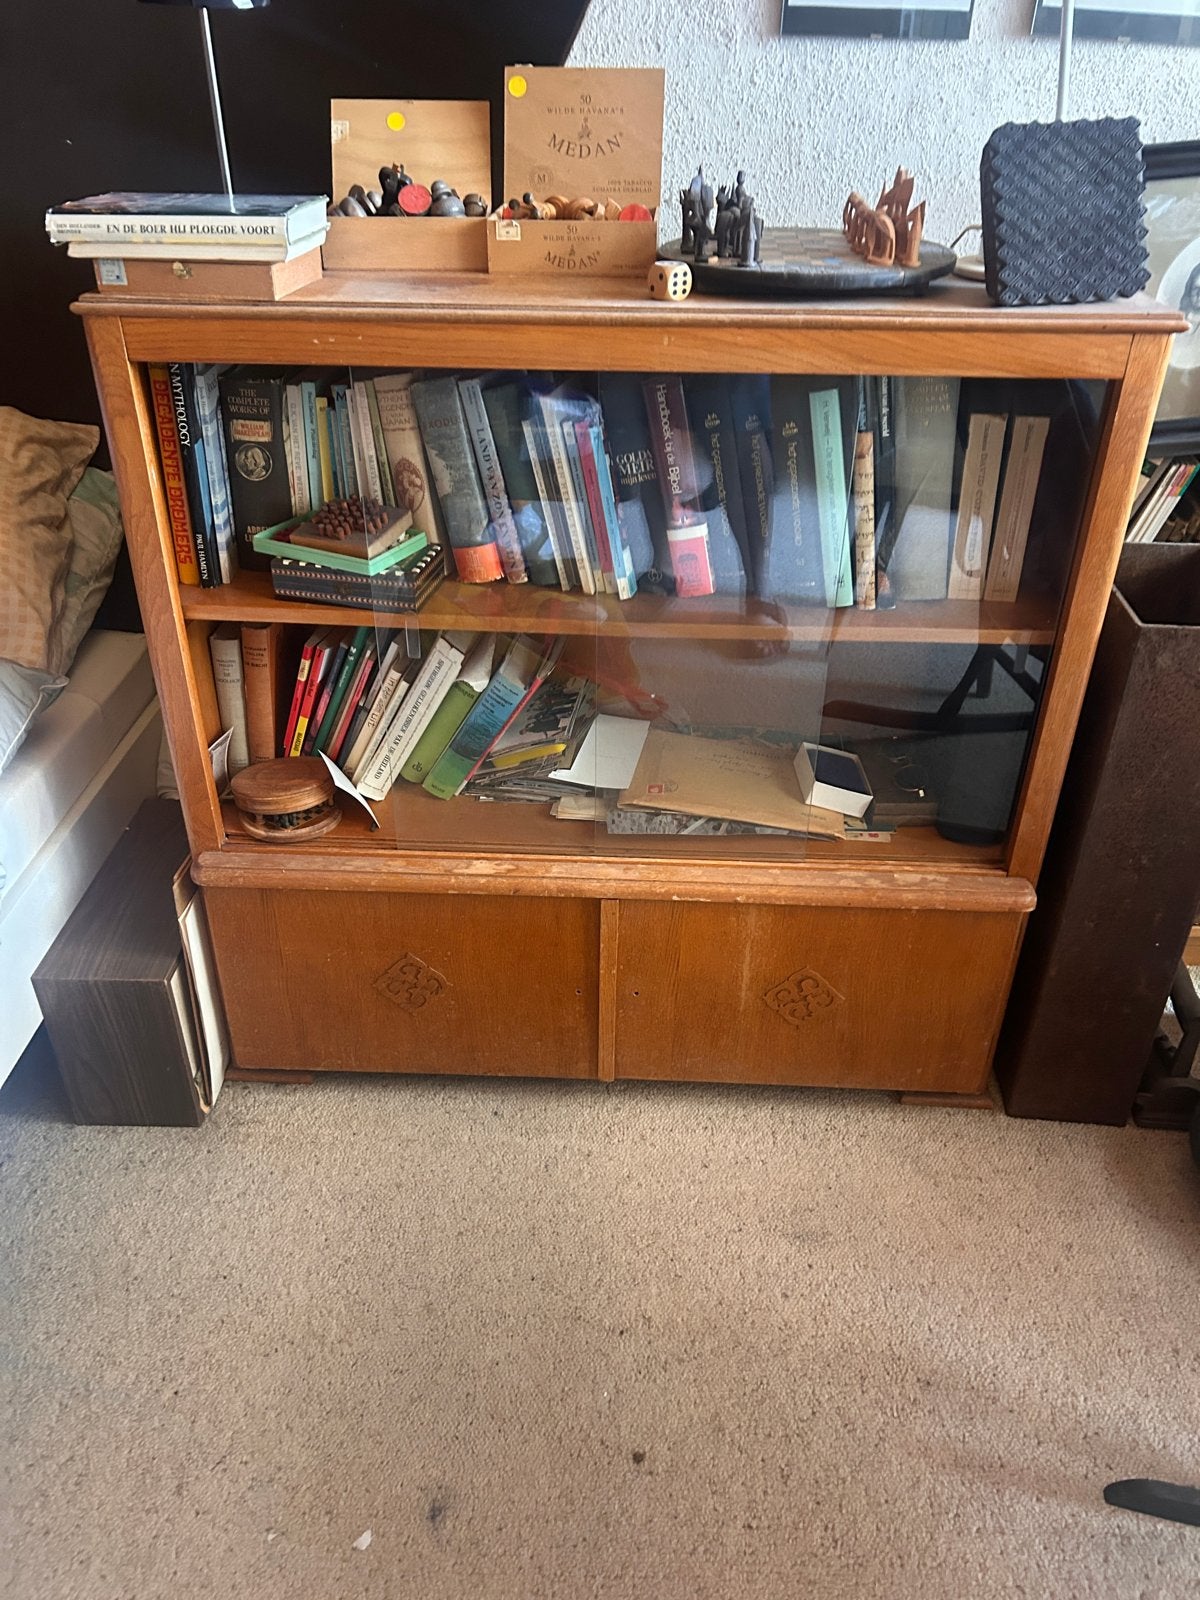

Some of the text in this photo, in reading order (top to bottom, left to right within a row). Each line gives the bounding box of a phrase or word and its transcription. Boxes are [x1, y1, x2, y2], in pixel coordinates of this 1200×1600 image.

[580, 94, 592, 105] 50
[579, 106, 624, 114] HAVANA'S
[548, 133, 623, 159] MEDAN
[107, 224, 276, 236] EN DE BOER HIJ PLOEGDE VOORT
[566, 225, 578, 235] 50
[544, 251, 598, 270] MEDAN
[239, 388, 257, 397] THE
[228, 396, 270, 406] COMPLETE
[171, 376, 191, 447] MYTHOLOGY
[229, 405, 270, 415] WORKS OF
[475, 427, 491, 463] LAND
[656, 384, 683, 495] Handboek bij de Bijbel
[616, 450, 652, 464] GOLDA
[153, 379, 193, 565] DECADENTE DROMERS
[619, 460, 654, 475] MEIR
[485, 465, 499, 491] VAN
[491, 493, 505, 519] ZON
[199, 551, 208, 580] HAMLYN
[387, 676, 397, 687] in
[423, 658, 445, 689] SPURGEON
[365, 712, 379, 729] uit
[392, 733, 402, 746] VAN
[387, 746, 396, 754] DE
[373, 753, 392, 780] HEILAND
